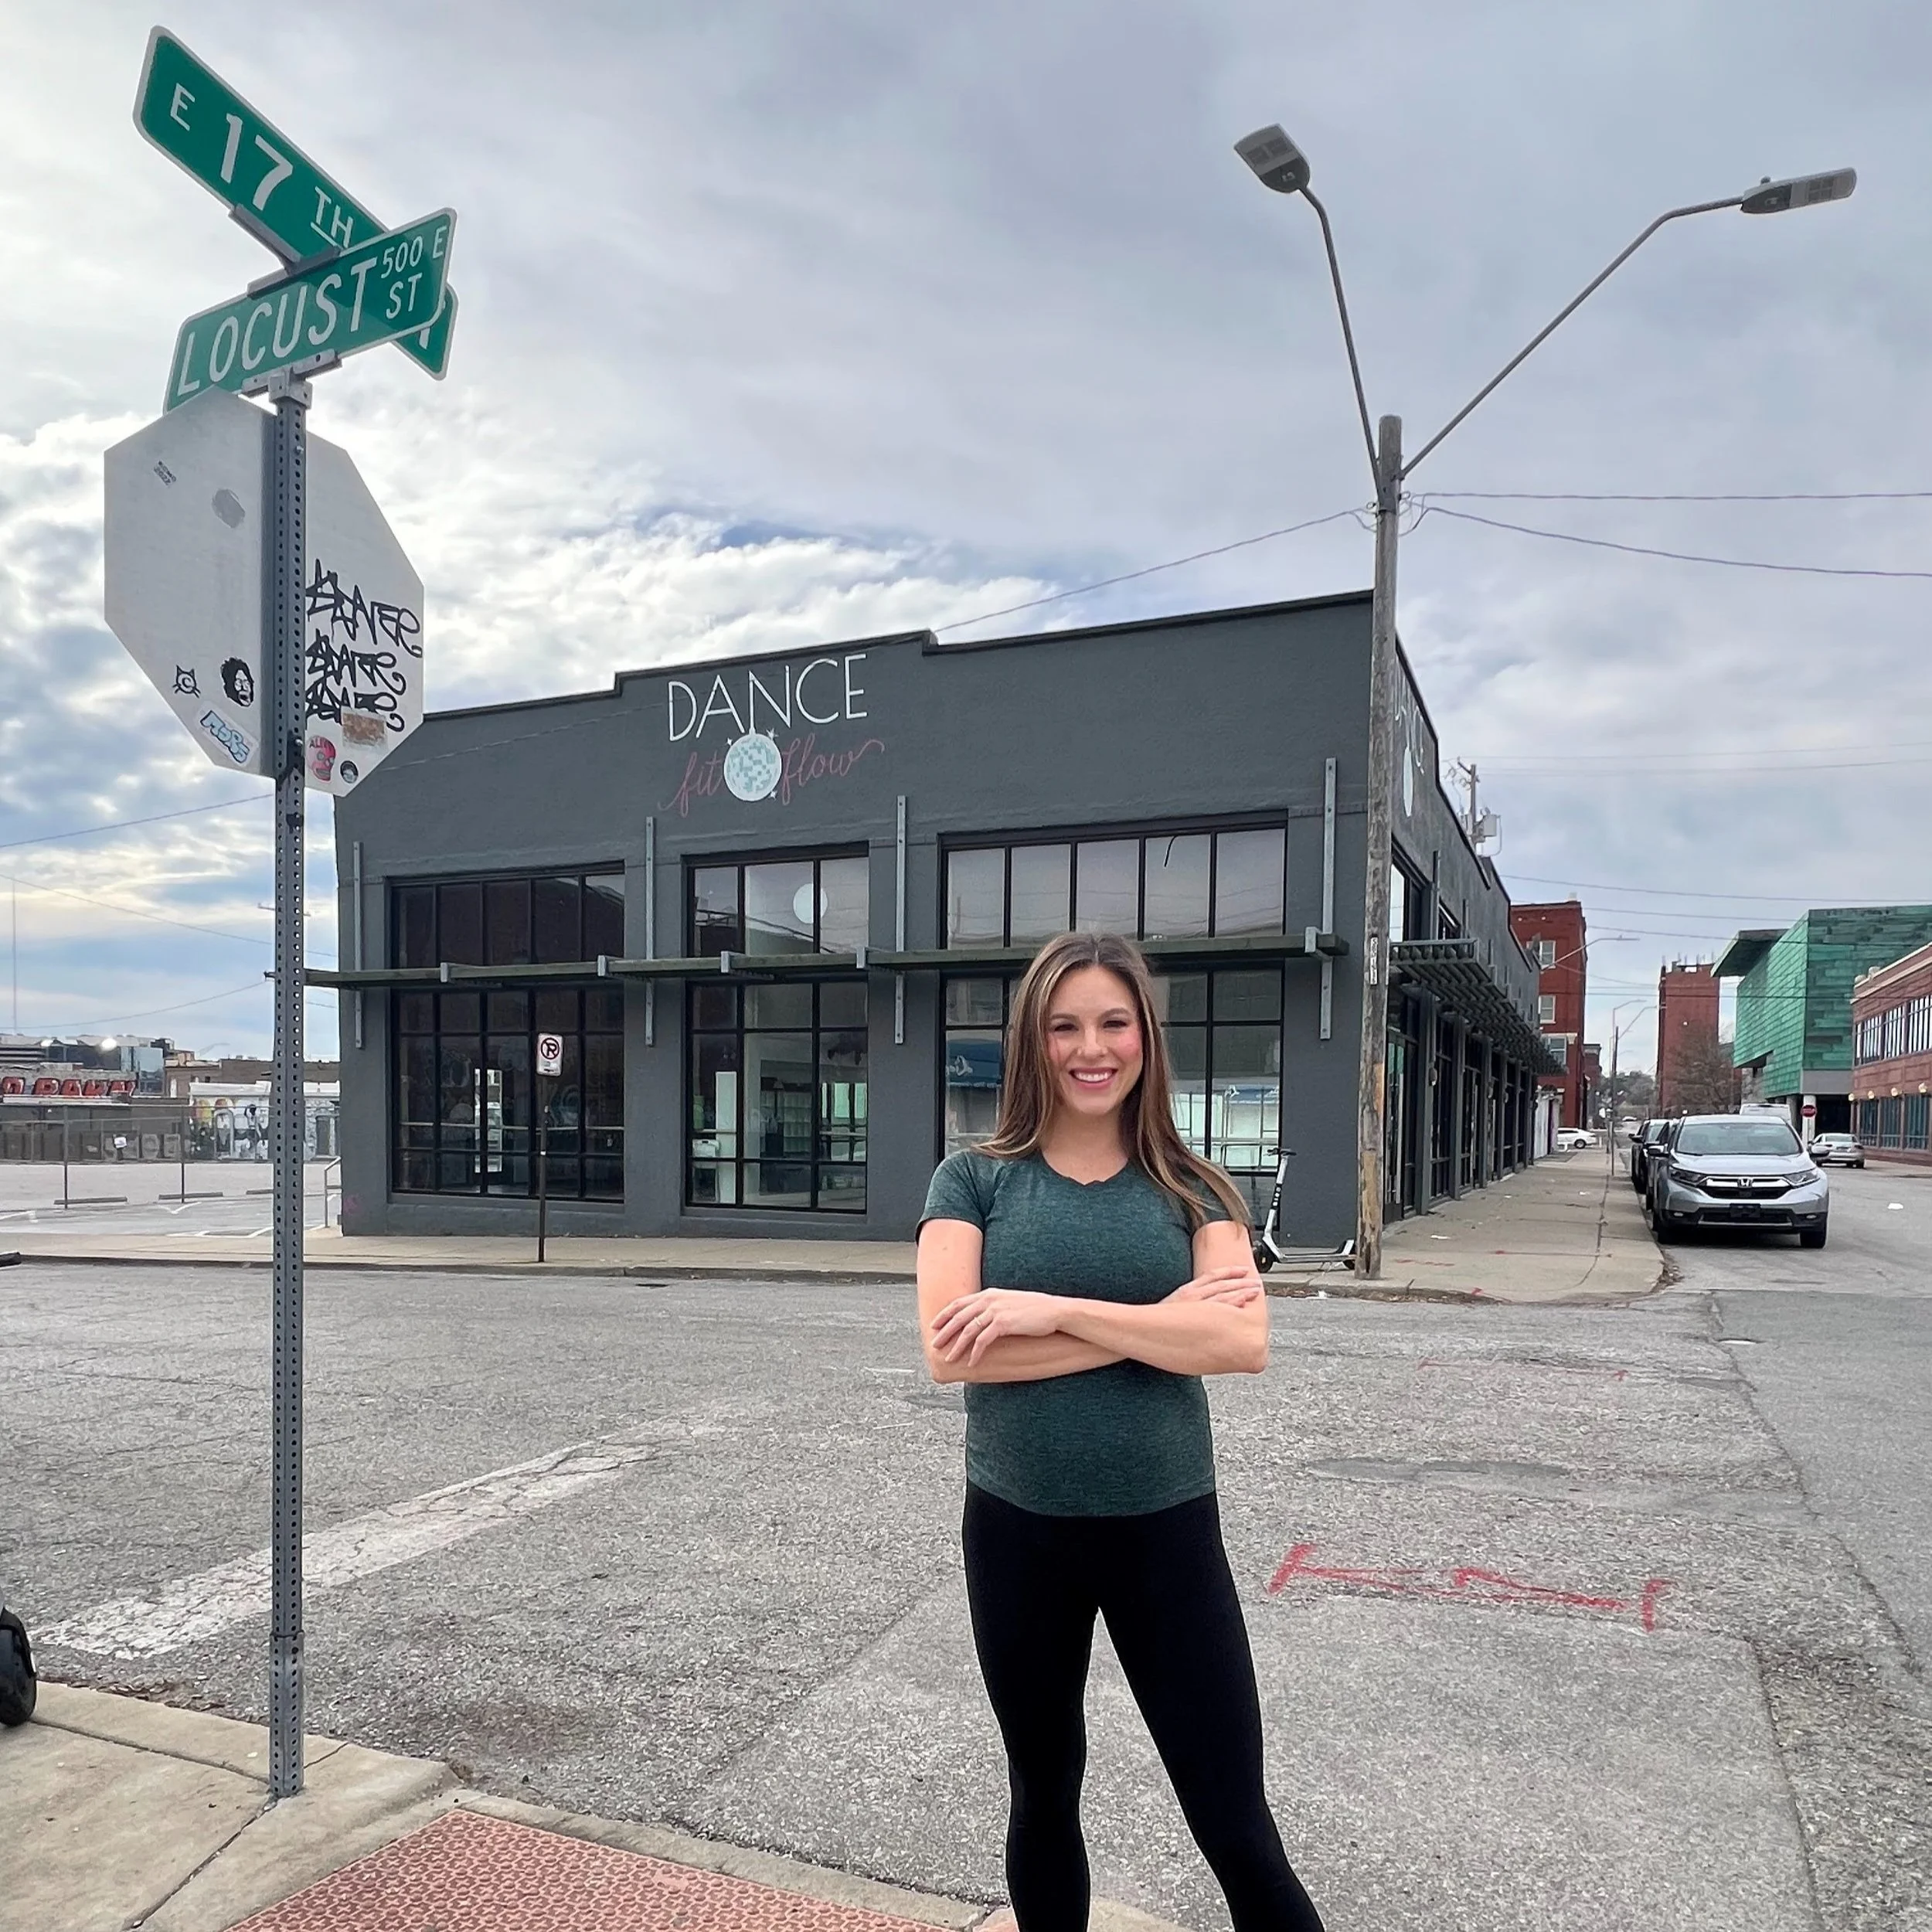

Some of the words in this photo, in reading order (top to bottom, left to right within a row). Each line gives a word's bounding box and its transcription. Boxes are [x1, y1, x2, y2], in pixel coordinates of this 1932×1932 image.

[170, 83, 196, 131] E
[381, 236, 423, 278] 500
[433, 226, 447, 258] E
[177, 257, 378, 396] LOCUST
[386, 273, 423, 319] ST
[668, 654, 868, 741] DANCE
[658, 750, 723, 818] fit
[781, 733, 886, 805] flow
